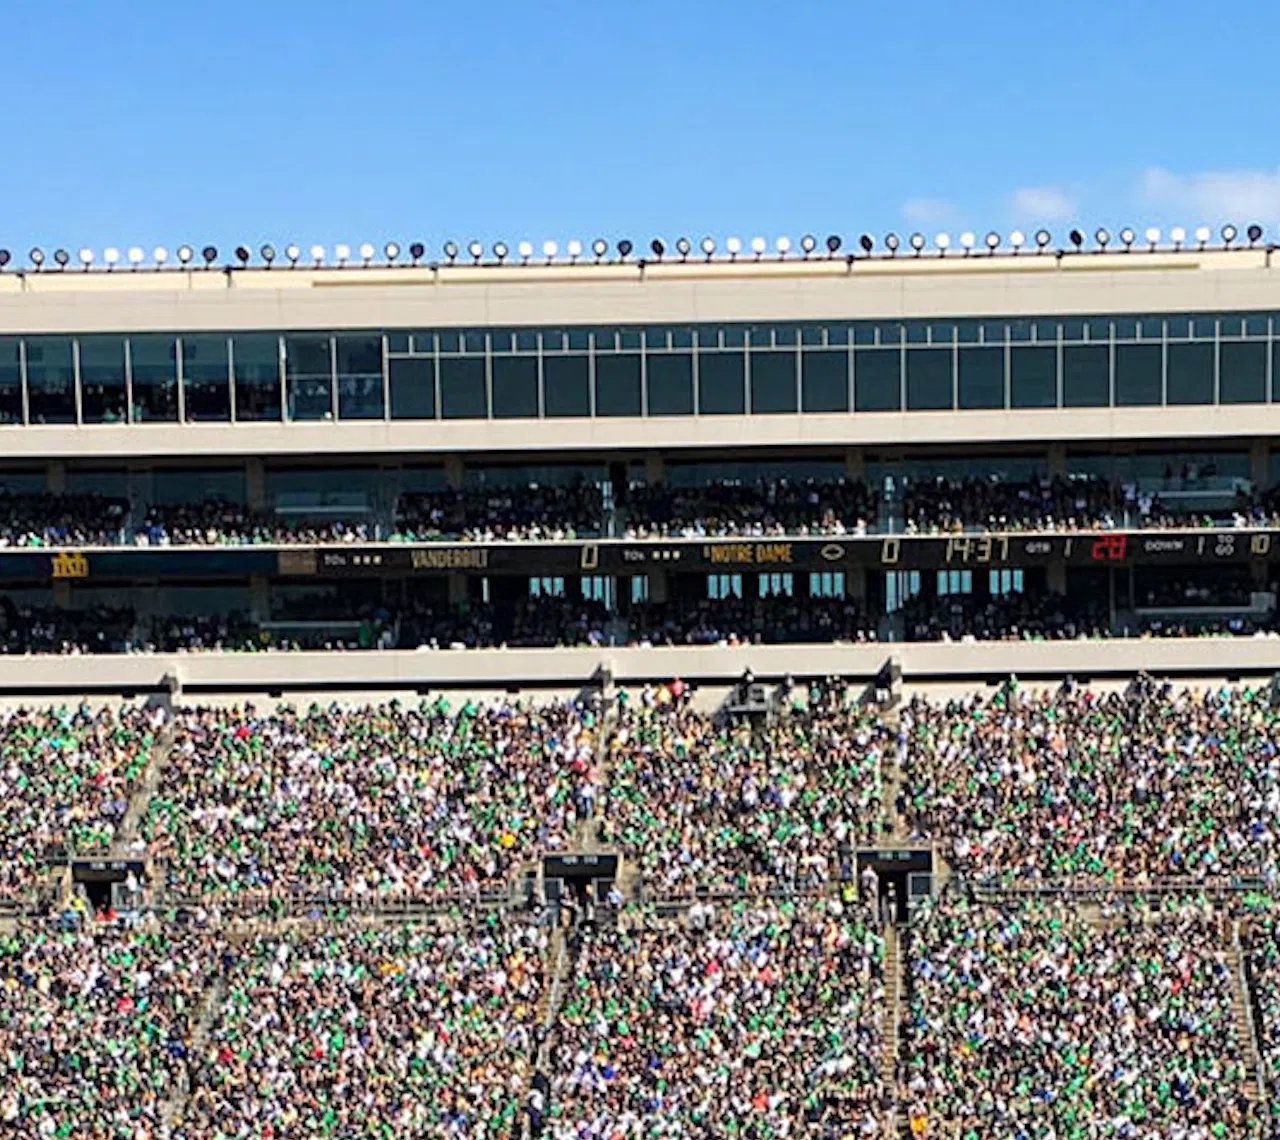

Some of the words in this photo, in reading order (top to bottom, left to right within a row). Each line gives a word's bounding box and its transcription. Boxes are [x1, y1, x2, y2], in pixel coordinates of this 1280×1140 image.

[711, 544, 754, 563] NOTRE
[756, 543, 793, 562] DAME
[945, 536, 1010, 562] 14:37
[1250, 534, 1272, 553] 10
[410, 549, 489, 569] VANDERBILT
